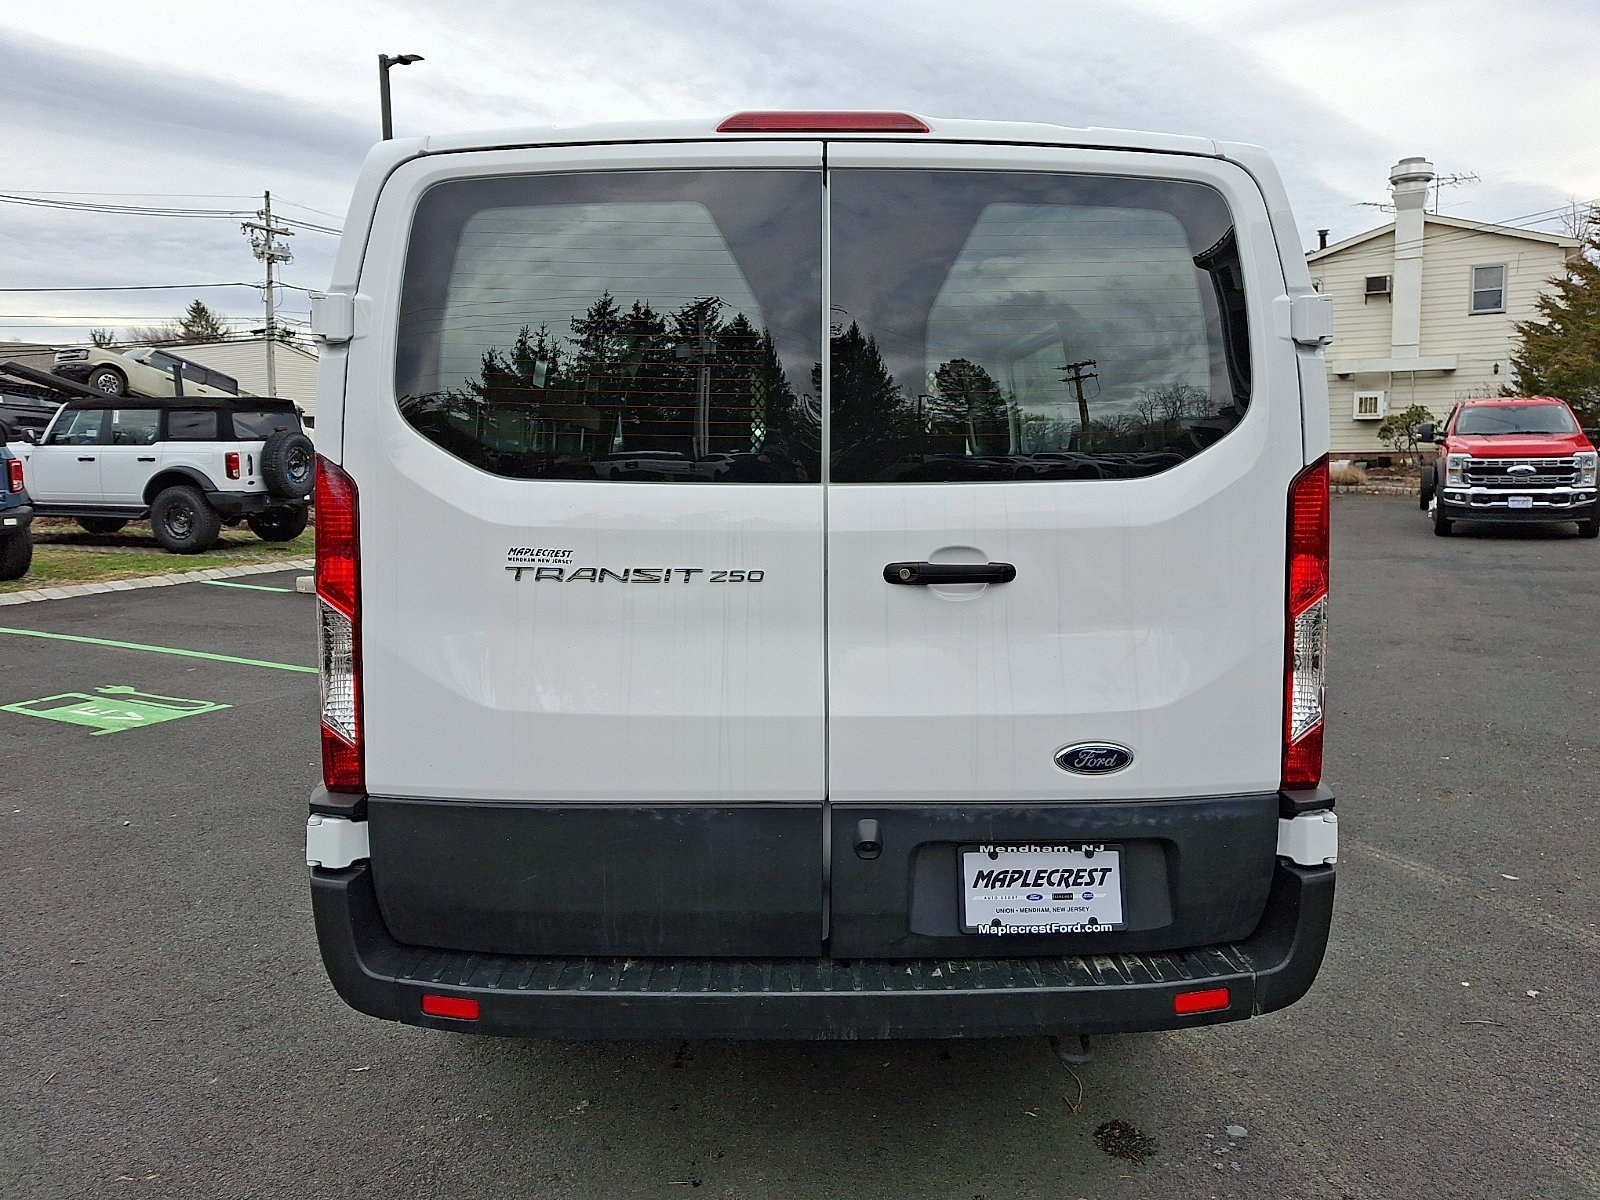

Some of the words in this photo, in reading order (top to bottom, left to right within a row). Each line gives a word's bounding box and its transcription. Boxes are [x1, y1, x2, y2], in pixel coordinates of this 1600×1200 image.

[507, 547, 573, 558] MAPLECREST
[505, 566, 704, 584] TRANSIT
[709, 570, 765, 583] 250
[1074, 749, 1118, 768] Ford
[979, 844, 1075, 854] Mendham,
[1081, 844, 1105, 852] NJ
[972, 867, 1113, 891] MAPLECREST
[977, 923, 1113, 936] MaplecrestFord.com
